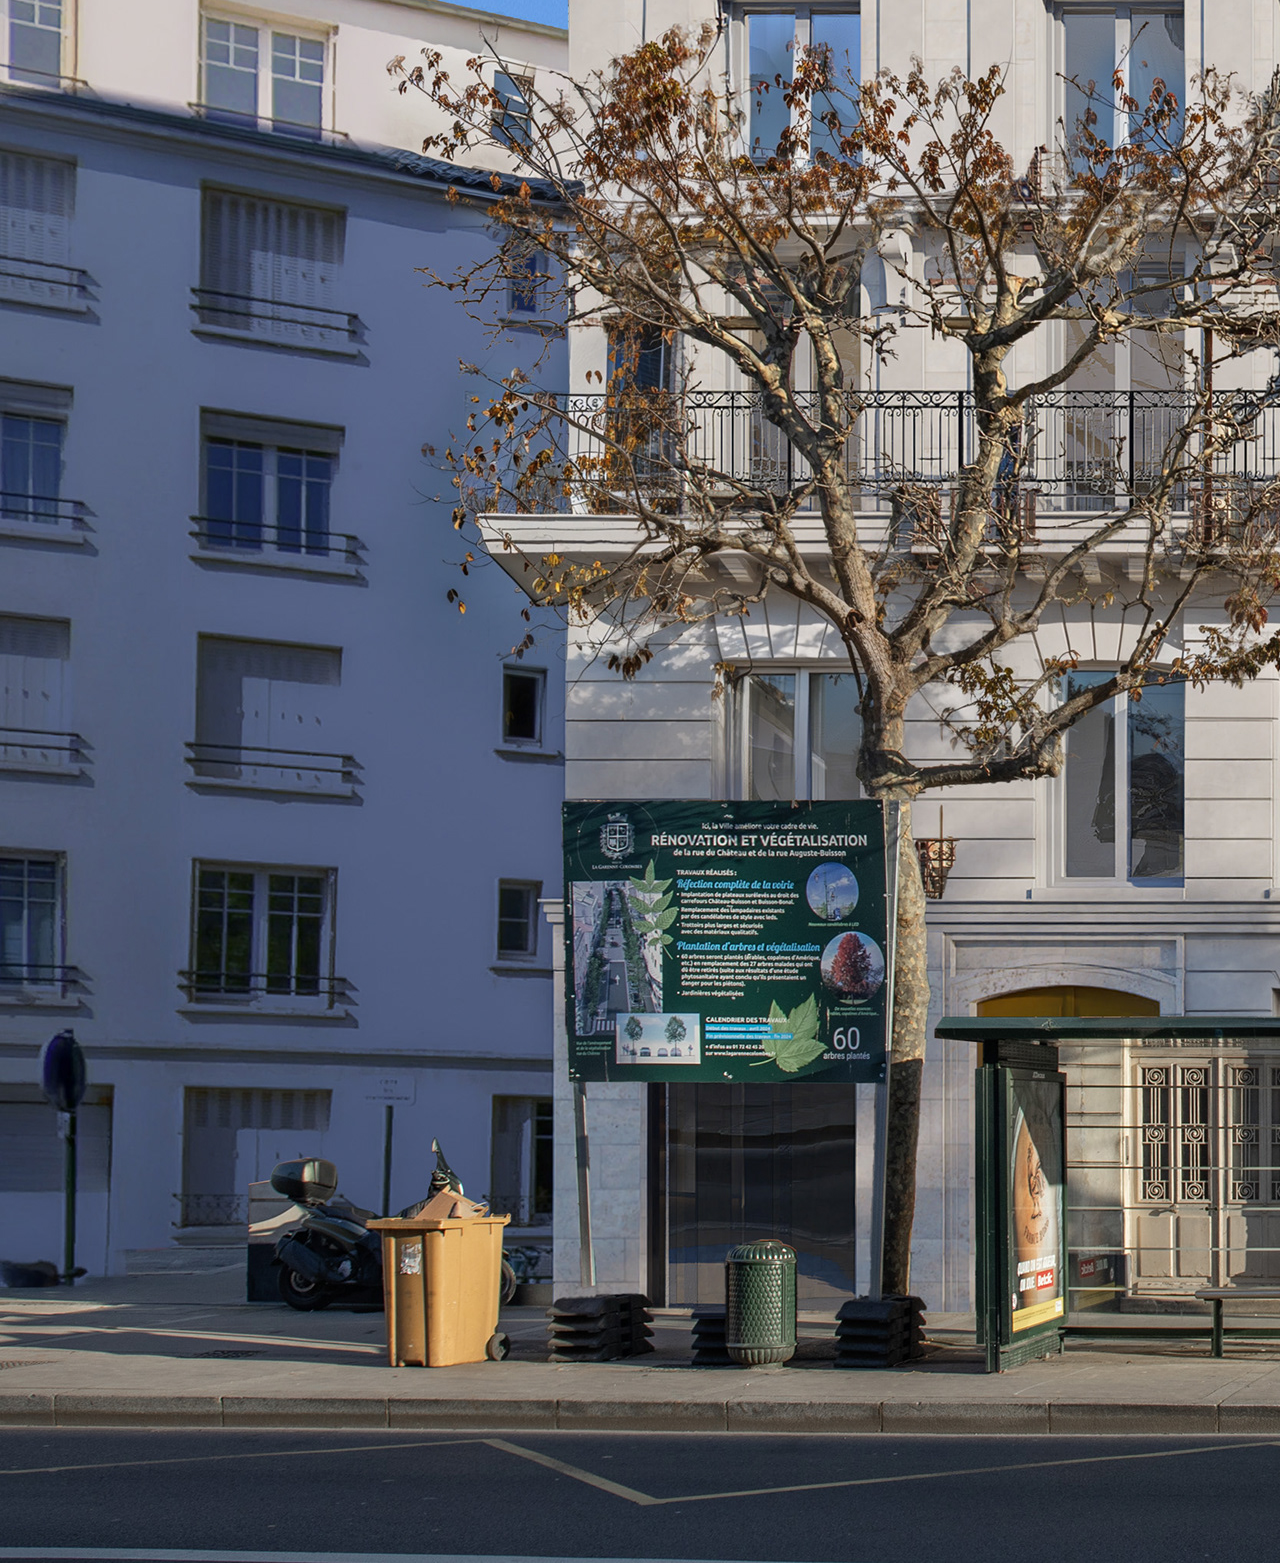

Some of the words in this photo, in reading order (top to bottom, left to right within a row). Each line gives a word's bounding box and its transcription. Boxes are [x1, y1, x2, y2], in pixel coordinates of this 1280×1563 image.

[702, 823, 711, 831] Ici,
[651, 832, 737, 847] RÉNOVATION
[741, 835, 758, 847] ET
[760, 832, 868, 847] VÉGÉTALISATION
[748, 849, 756, 857] et
[757, 849, 767, 857] de
[768, 849, 775, 857] la
[776, 849, 788, 857] rue
[789, 850, 846, 858] Auguste-Buisson
[676, 879, 713, 890] Réfection
[714, 879, 749, 891] complète
[751, 879, 761, 890] de
[762, 879, 771, 890] la
[771, 880, 794, 890] voirie
[677, 941, 720, 952] Plantation
[722, 941, 756, 953] d'arbres
[757, 941, 764, 953] et
[766, 942, 820, 954] végétalisation
[833, 1027, 860, 1050] 60
[823, 1052, 845, 1060] arbres
[846, 1052, 870, 1061] plantés
[1037, 1272, 1053, 1287] Betclic
